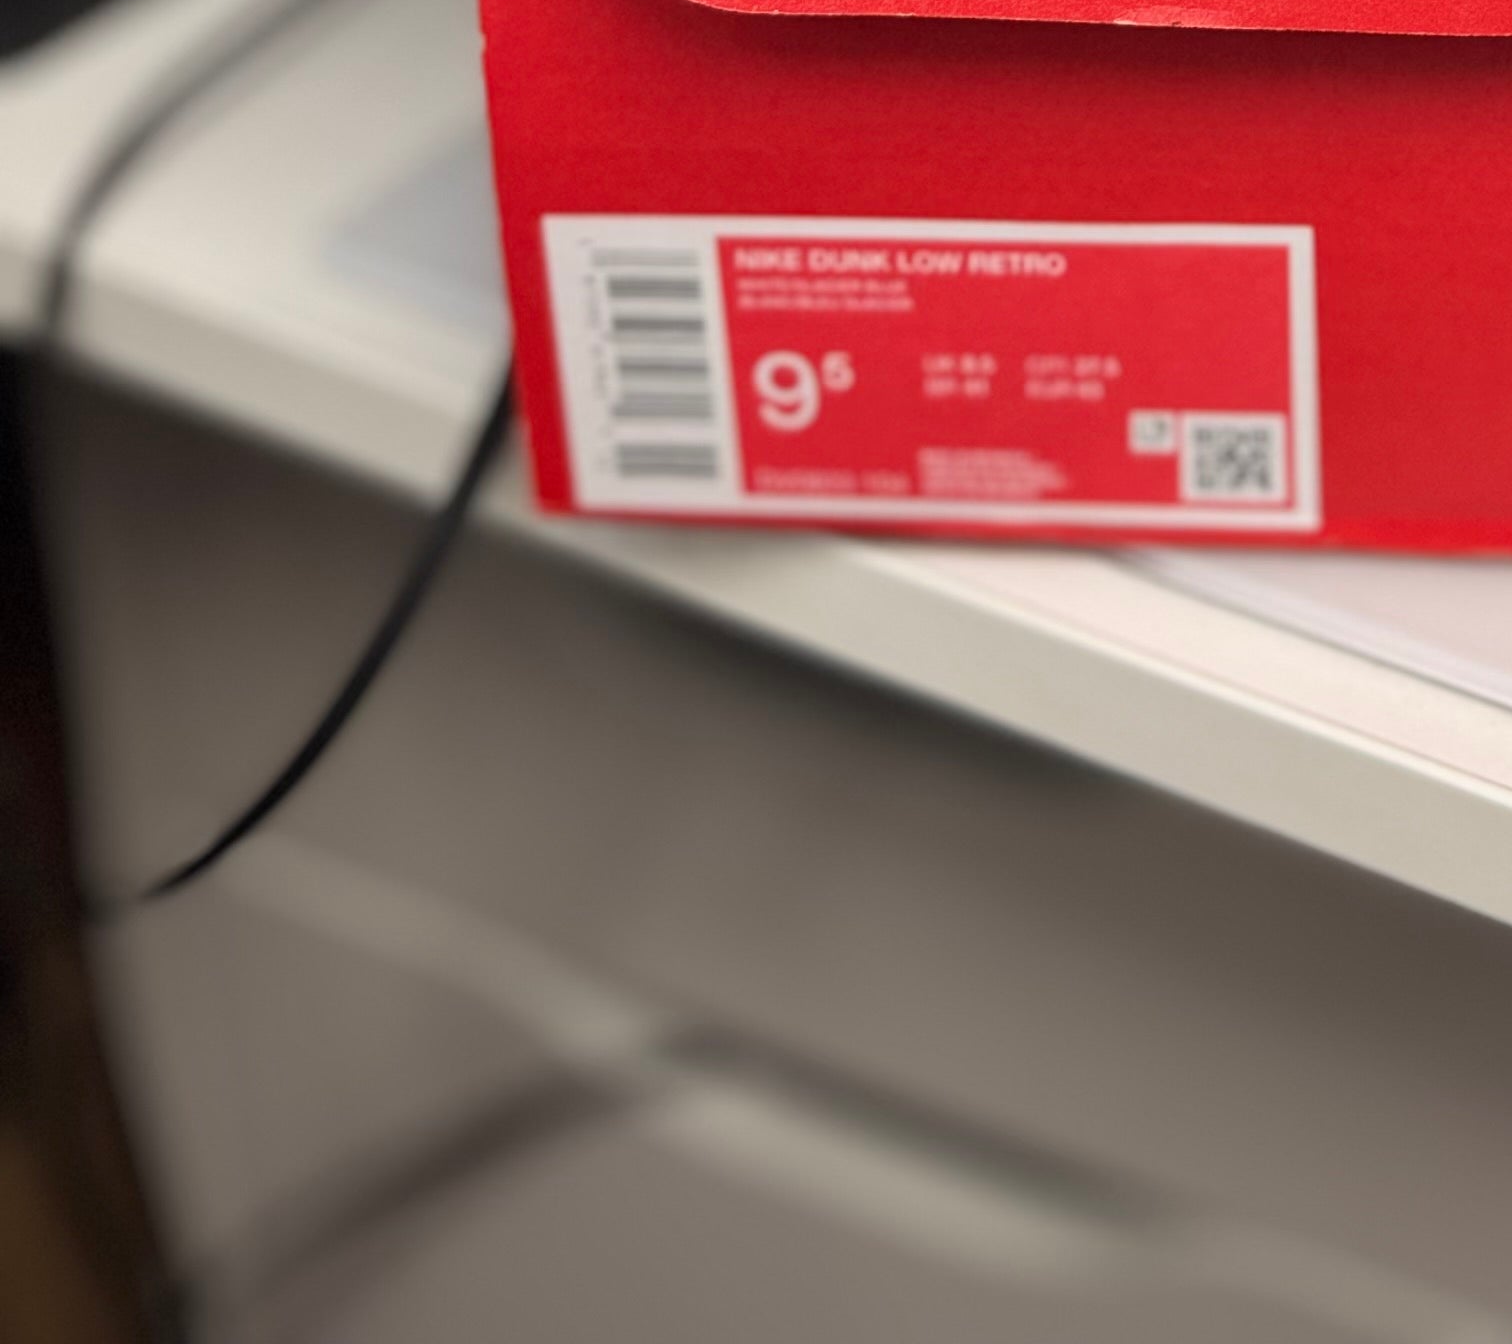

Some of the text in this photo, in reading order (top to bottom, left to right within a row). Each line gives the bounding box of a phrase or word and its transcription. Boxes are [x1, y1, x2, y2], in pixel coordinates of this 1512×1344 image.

[734, 247, 1068, 277] NIKE DUNK LOW RETRO
